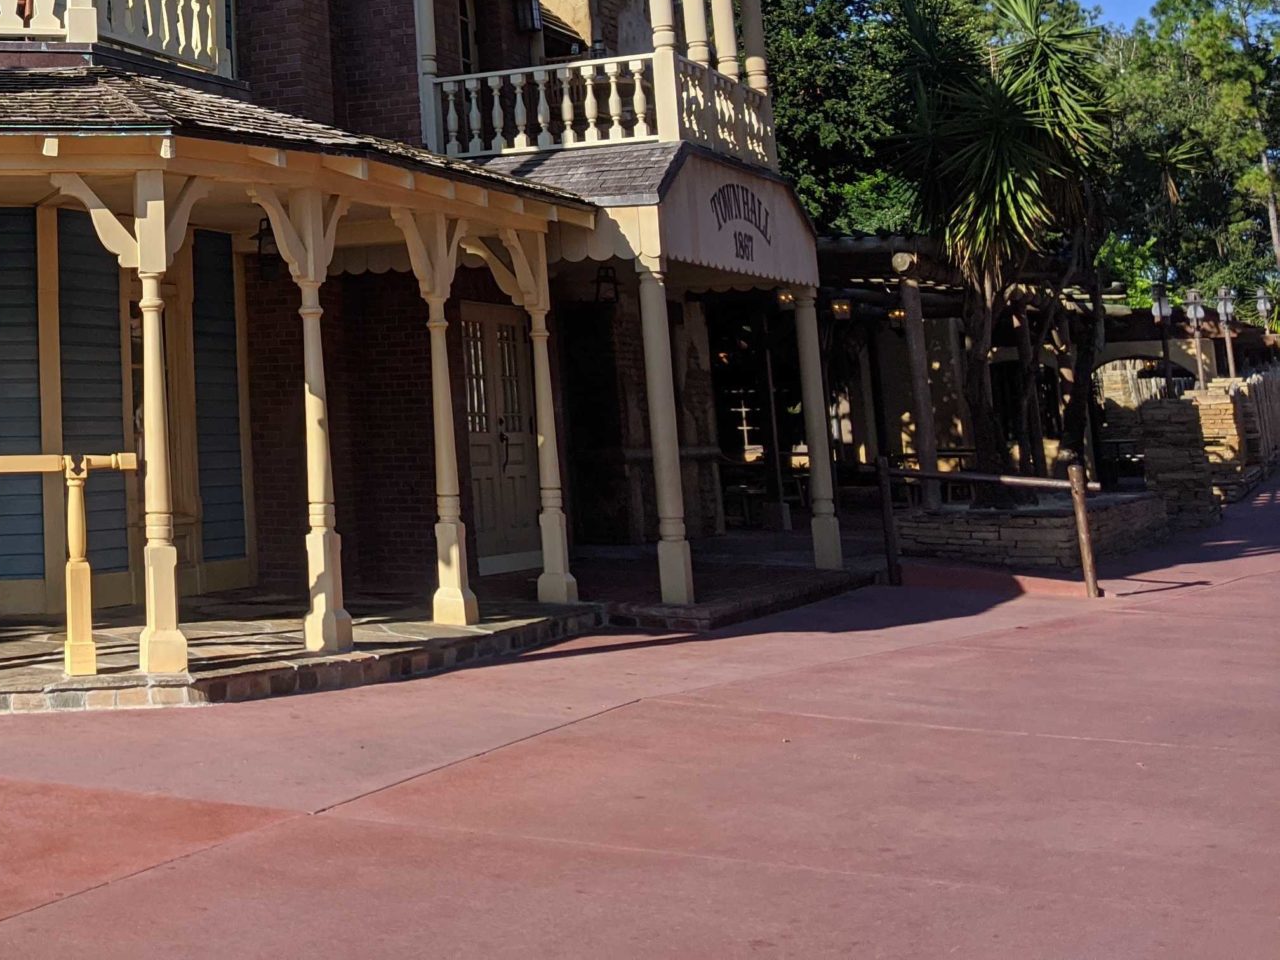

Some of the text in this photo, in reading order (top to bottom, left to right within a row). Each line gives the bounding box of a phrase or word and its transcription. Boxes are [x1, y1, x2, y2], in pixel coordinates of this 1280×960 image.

[709, 183, 772, 247] TOWN HALL
[733, 230, 754, 262] 1867
